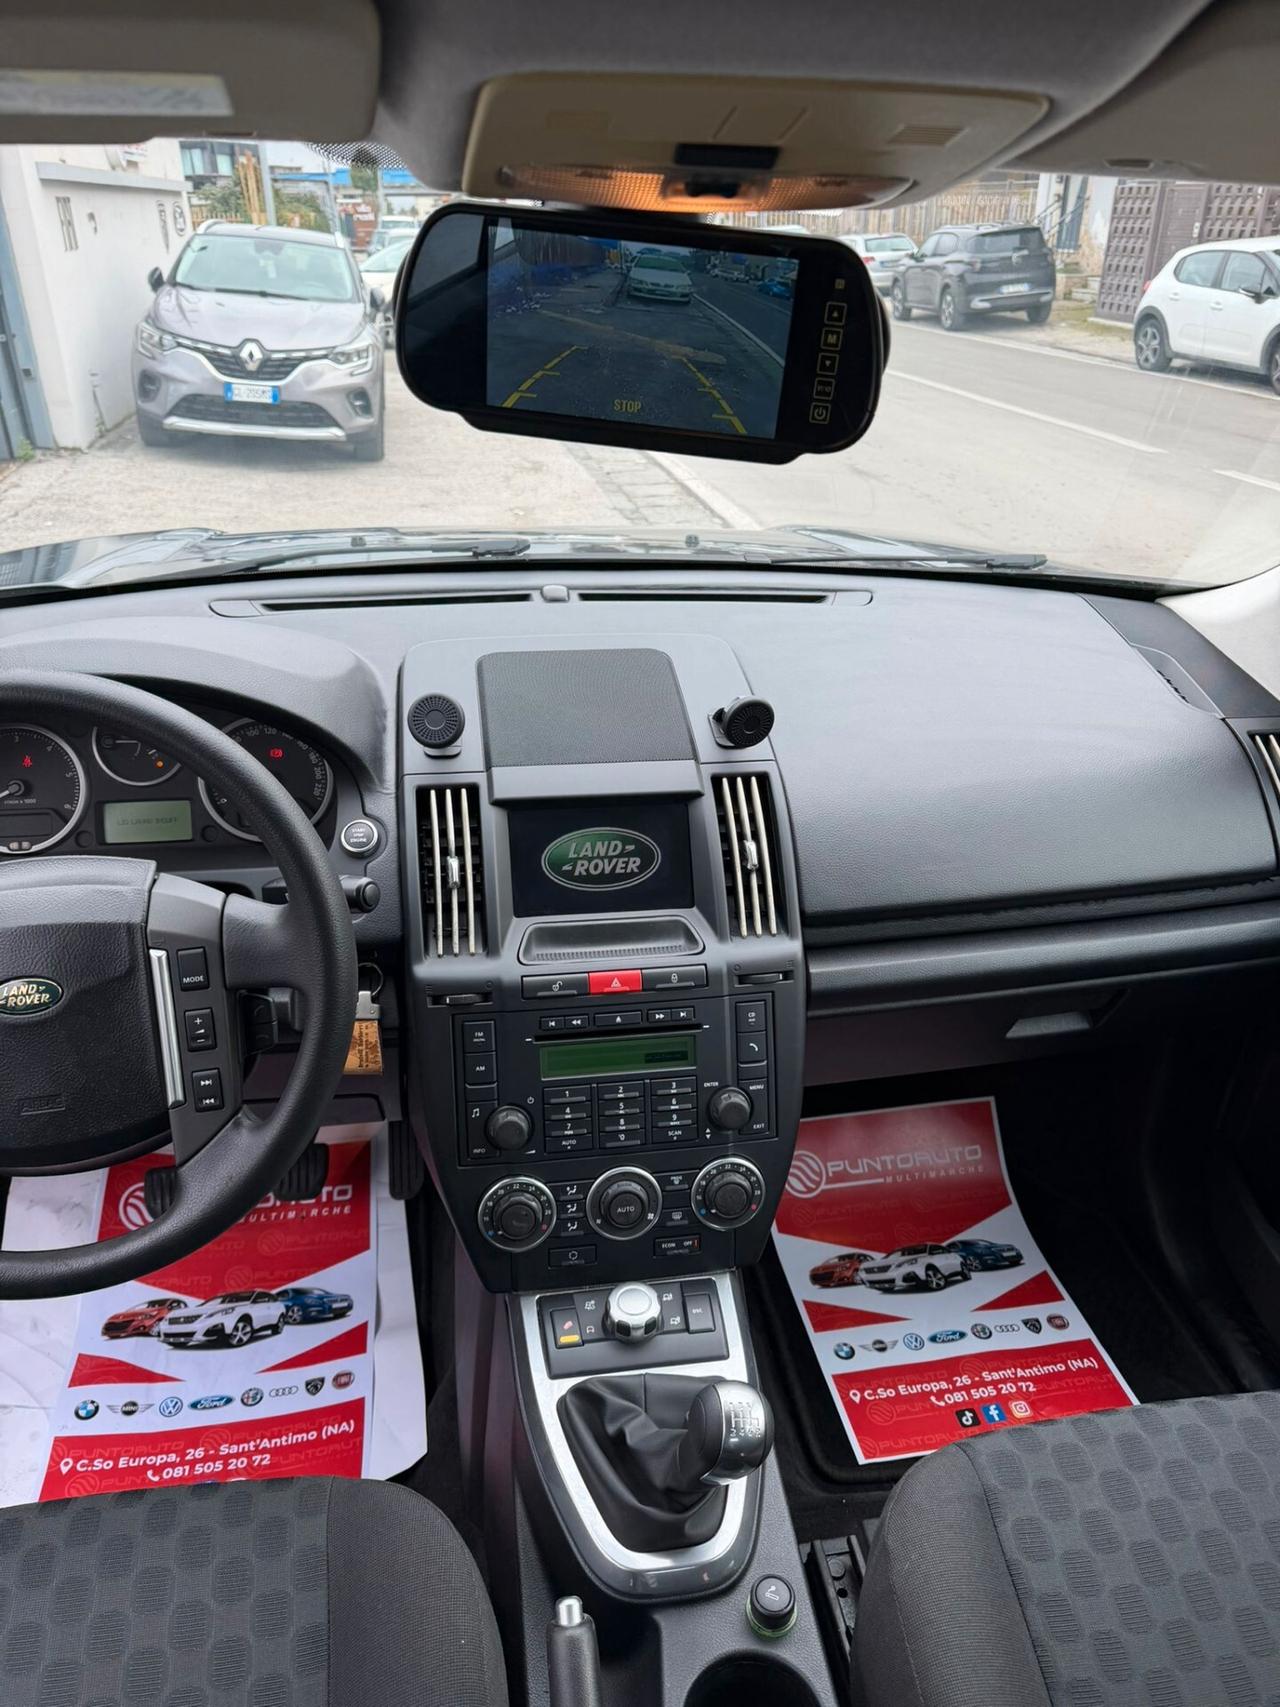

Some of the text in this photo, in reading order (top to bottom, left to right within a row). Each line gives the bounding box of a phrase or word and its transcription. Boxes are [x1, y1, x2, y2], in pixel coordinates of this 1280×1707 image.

[614, 399, 641, 413] STOP
[568, 840, 622, 859] LAND
[573, 857, 641, 876] ROVER
[183, 975, 204, 984] MODE
[2, 983, 37, 996] LAND
[6, 993, 50, 1008] ROVER
[672, 1097, 677, 1105] 6
[672, 1113, 677, 1121] 9
[826, 1144, 982, 1177] PUNTOAUTO
[885, 1165, 985, 1184] MULTIMARCHE
[616, 1206, 635, 1214] AUTO
[935, 1331, 961, 1344] Ford
[864, 1388, 896, 1401] C.So
[897, 1379, 953, 1395] Europa,
[953, 1374, 972, 1387] 26
[982, 1362, 1066, 1382] Sant'Antimo
[1068, 1357, 1099, 1371] (NA)
[944, 1381, 1037, 1405] 081 505 20 72
[196, 1396, 227, 1410] Ford
[69, 1440, 185, 1459] PUNTOAUTO
[76, 1458, 114, 1473] C.So
[118, 1454, 181, 1469] Europa,
[186, 1447, 205, 1461] 26
[219, 1428, 318, 1456] Sant'Antimo
[321, 1419, 355, 1440] (NA)
[162, 1454, 271, 1480] 081 505 20 72
